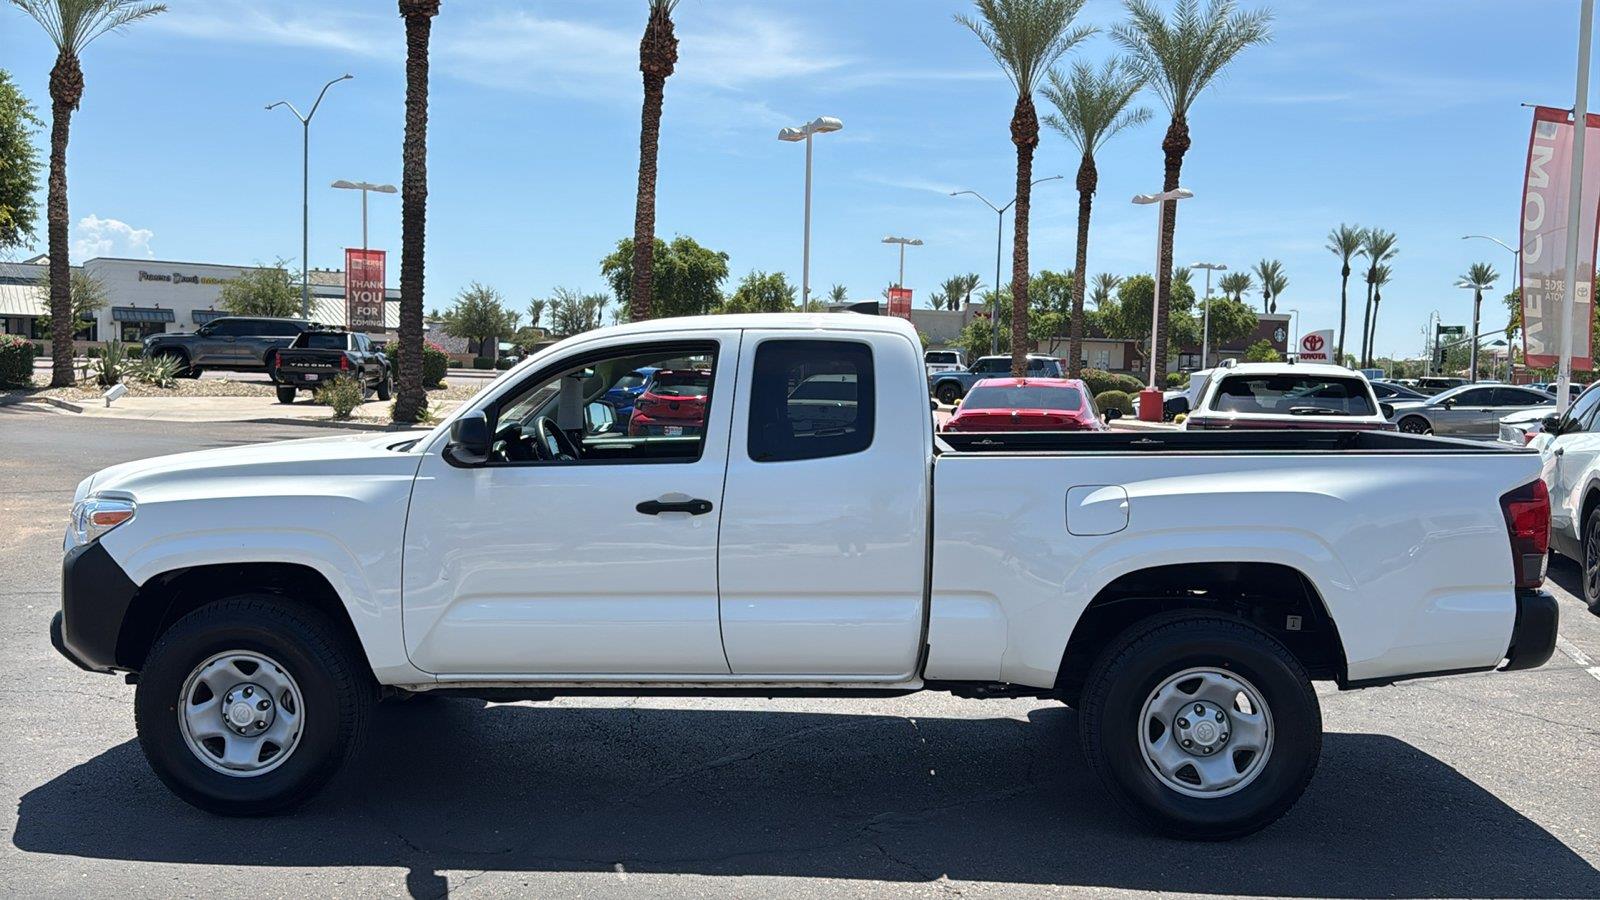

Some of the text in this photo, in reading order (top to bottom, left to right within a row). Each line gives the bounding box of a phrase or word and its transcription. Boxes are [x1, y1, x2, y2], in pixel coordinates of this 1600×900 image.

[351, 280, 384, 289] THANK
[352, 290, 382, 303] YOU
[357, 306, 379, 316] FOR
[351, 319, 384, 328] COMING!
